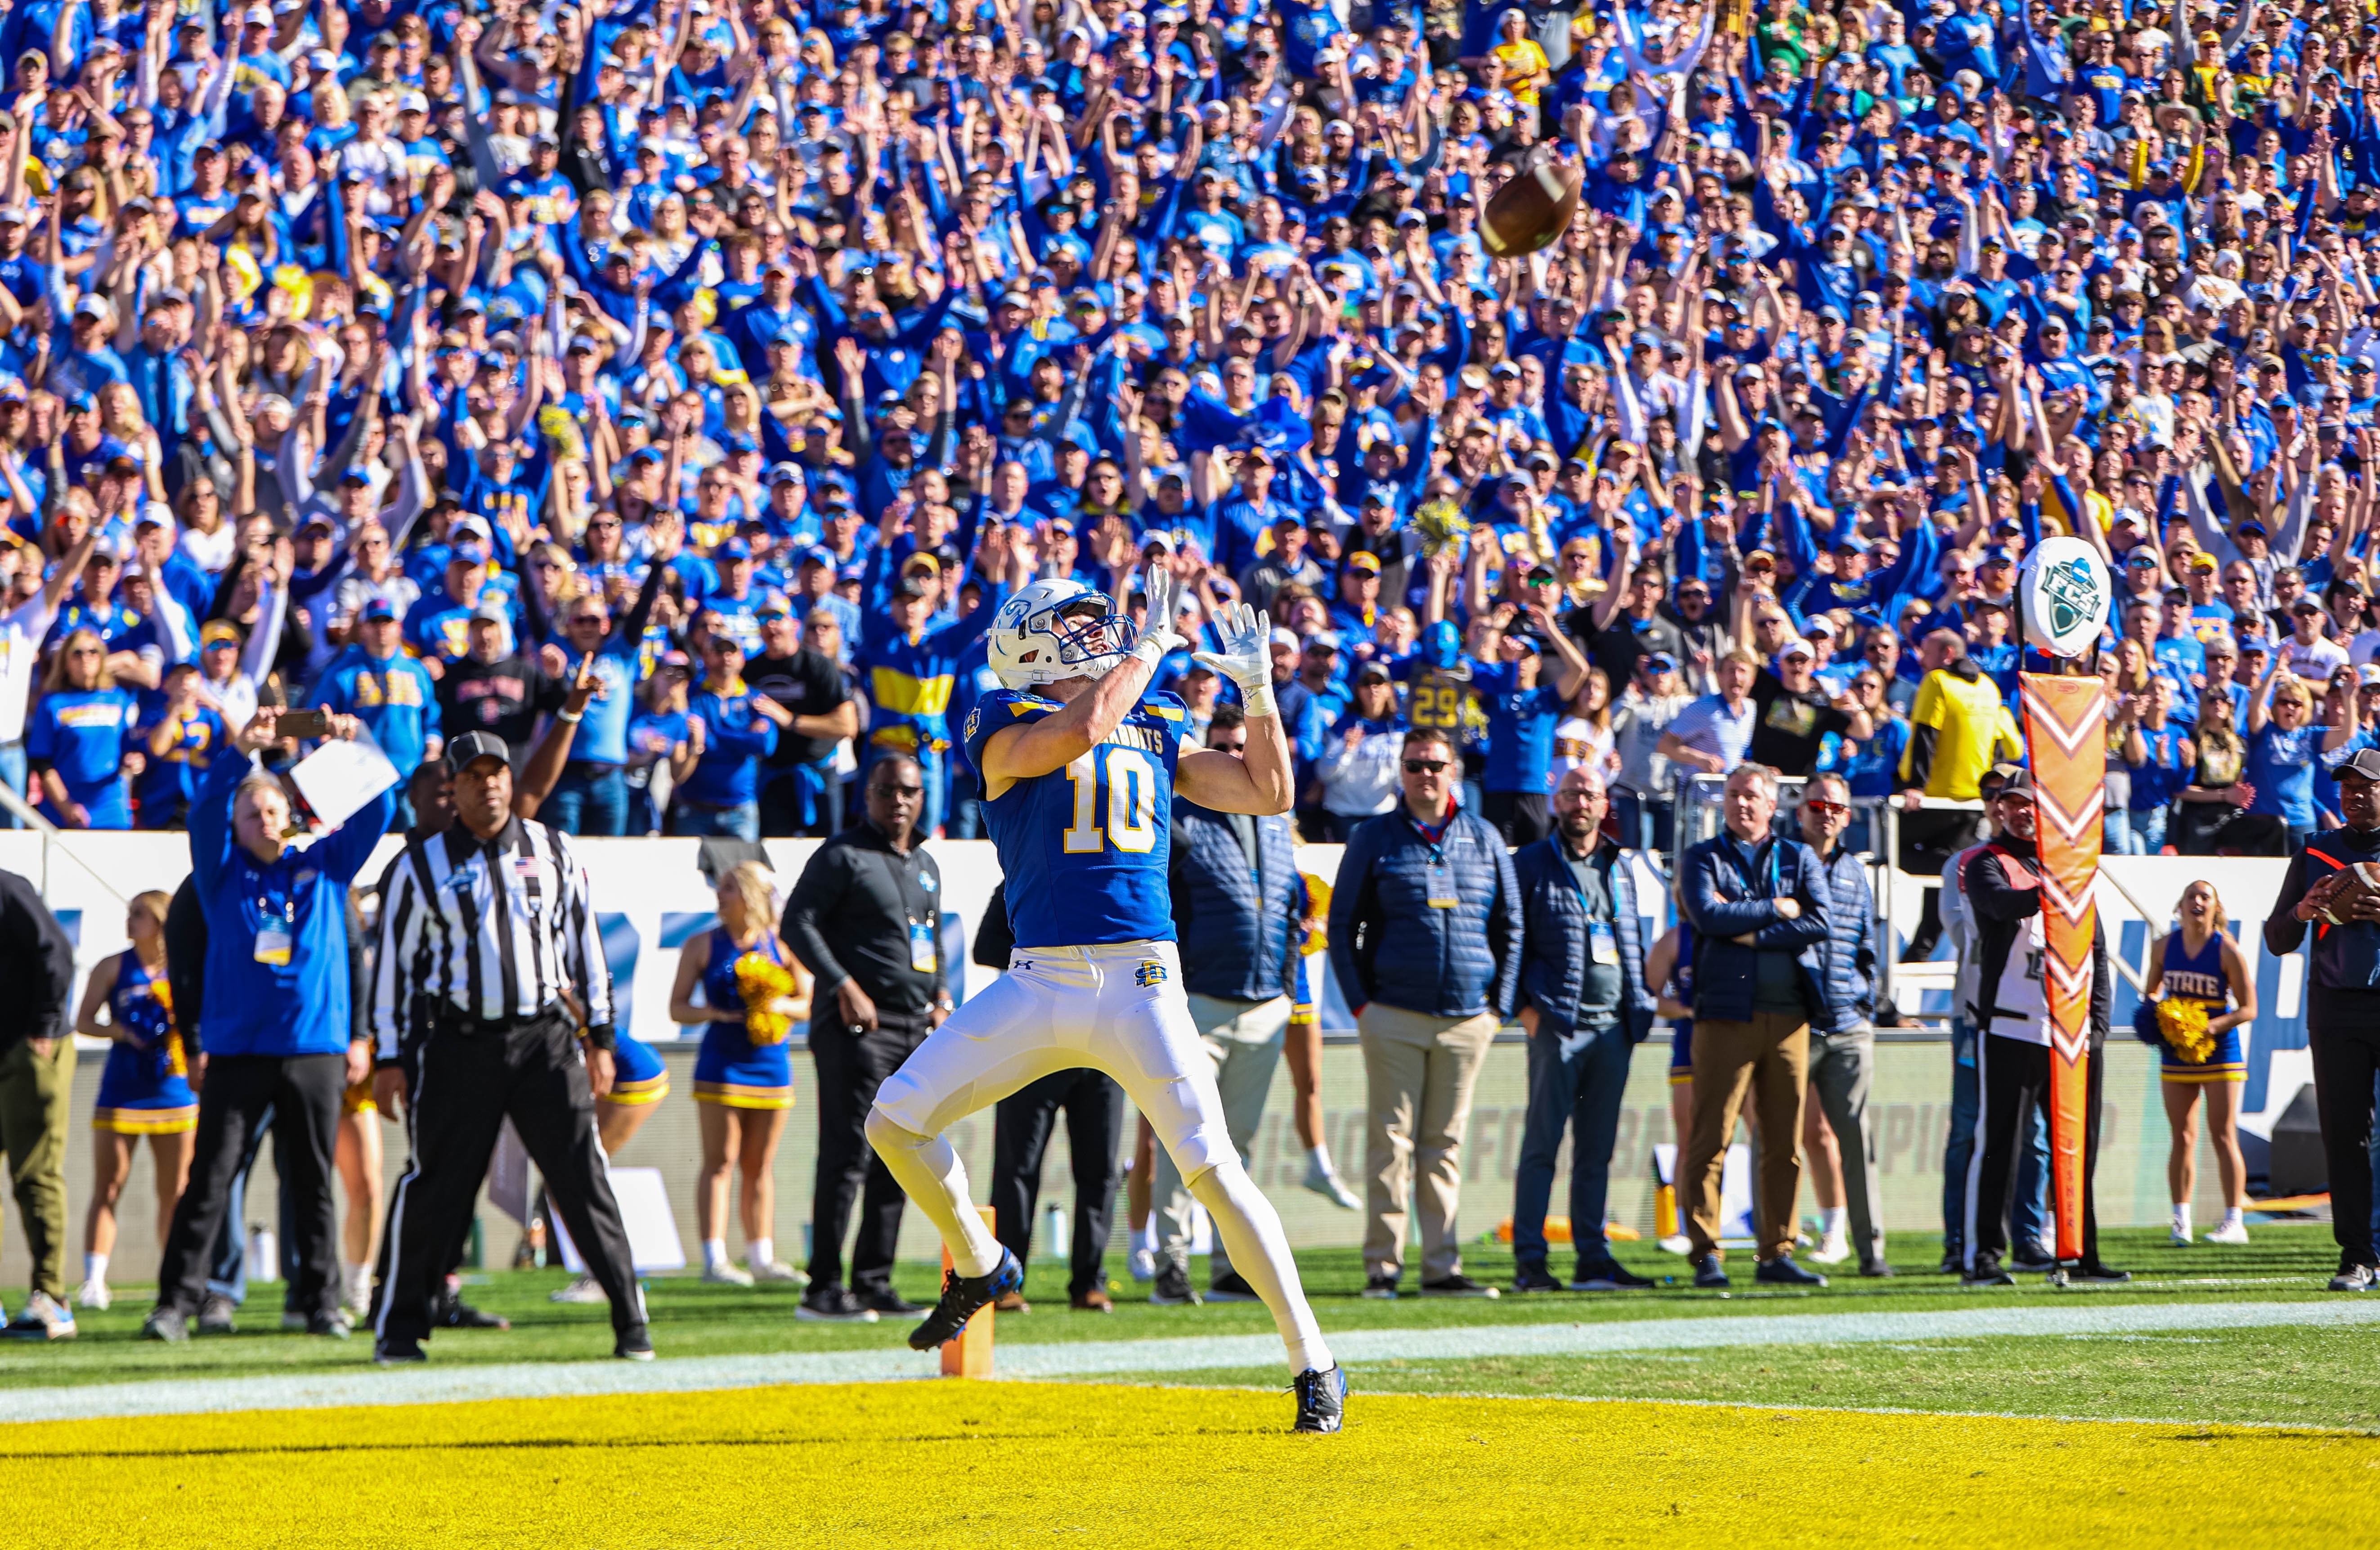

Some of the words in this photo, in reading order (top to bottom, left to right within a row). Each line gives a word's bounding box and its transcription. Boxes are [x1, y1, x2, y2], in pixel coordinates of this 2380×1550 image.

[2048, 573, 2097, 614] FCS
[1412, 687, 1458, 728] 29
[1064, 747, 1156, 853] 10
[2163, 970, 2219, 997] STATE
